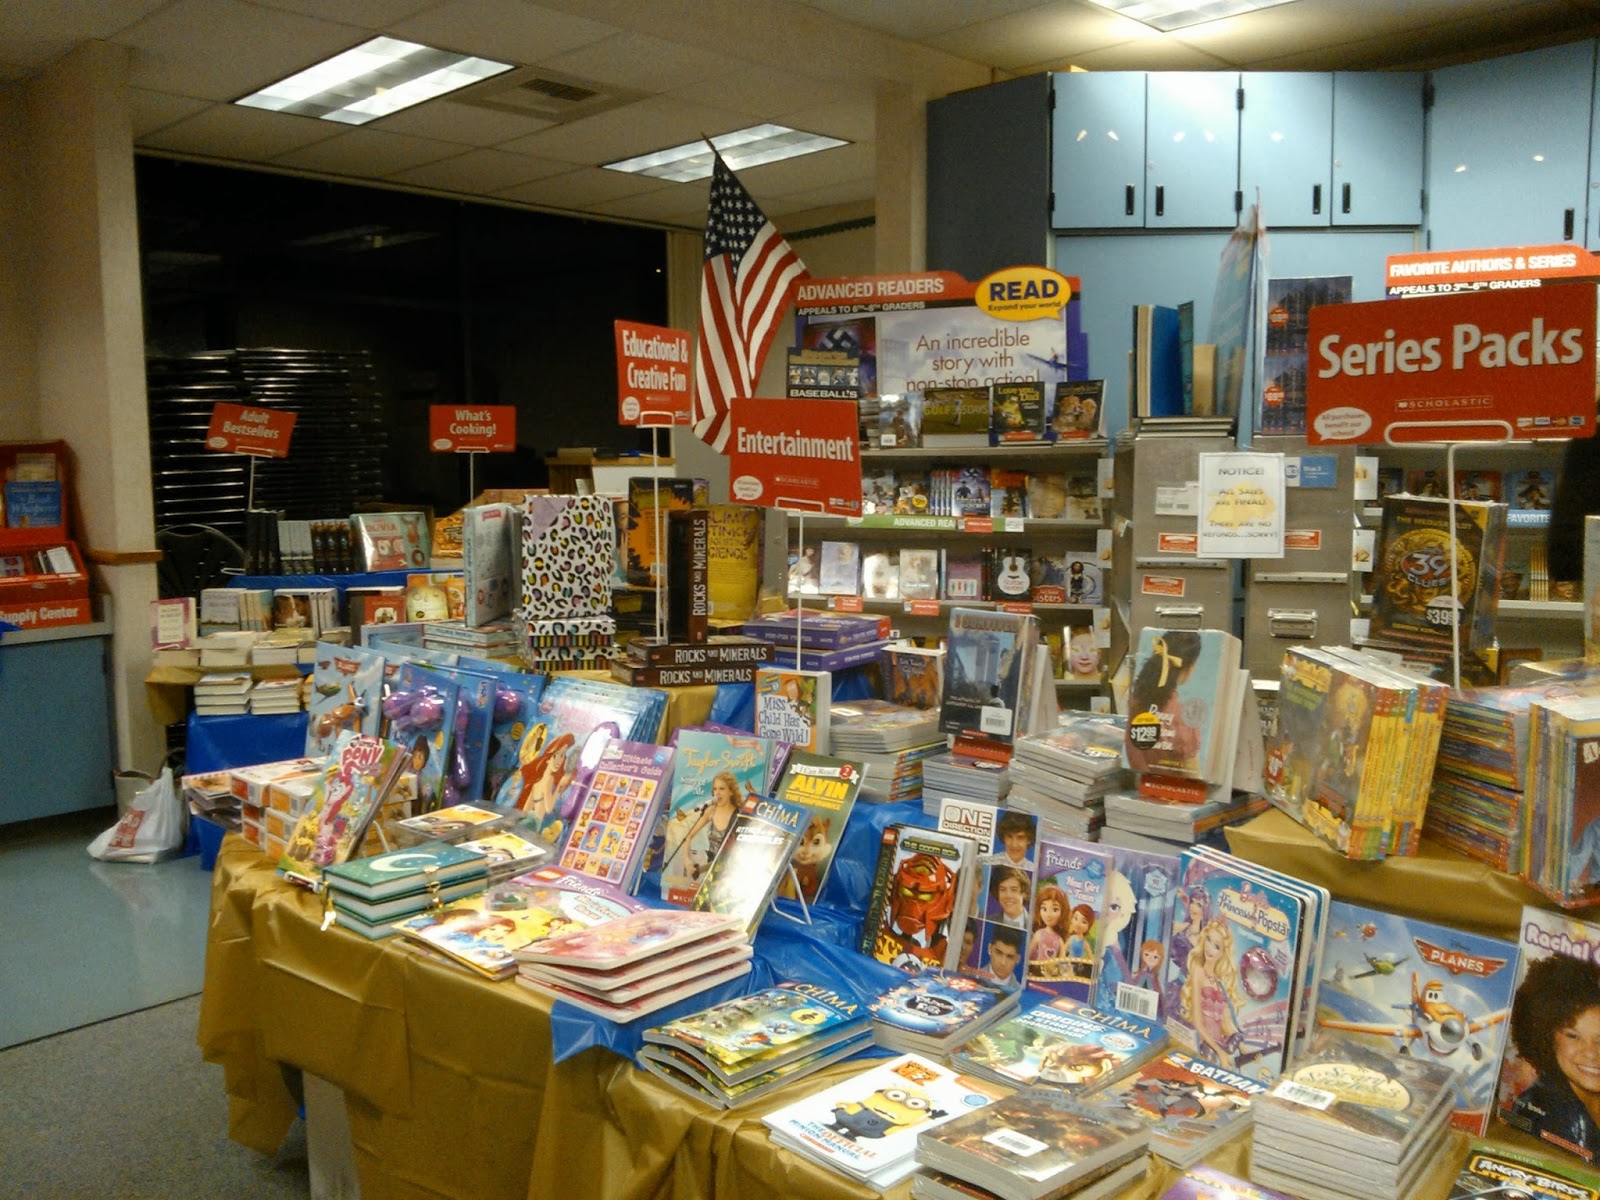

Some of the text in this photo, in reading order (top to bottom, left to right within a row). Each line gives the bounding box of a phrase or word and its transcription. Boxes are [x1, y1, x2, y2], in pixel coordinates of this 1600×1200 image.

[1390, 254, 1576, 277] FAVORITE AUTHORS & SERIES
[797, 278, 945, 301] ADVANCED READERS
[989, 278, 1059, 301] READ
[1389, 283, 1436, 295] APPEALS
[1437, 283, 1451, 293] TO
[1489, 279, 1541, 290] GRADERS
[798, 305, 837, 315] APPEALS
[838, 305, 851, 314] TO
[882, 301, 925, 311] GRADERS
[988, 301, 1061, 312] Expand your world
[622, 329, 688, 363] Educational &
[916, 328, 1030, 352] An incredible
[1318, 317, 1583, 378] Series Packs
[932, 351, 1014, 374] story with
[627, 362, 686, 391] Creative Fun
[790, 388, 858, 399] BASEBALL'S
[1408, 397, 1490, 408] SCHOLASTIC
[240, 409, 270, 424] Adult
[455, 409, 491, 422] What's
[223, 420, 279, 440] Bestsellers
[450, 422, 496, 437] Cooking!
[737, 427, 854, 462] Entertainment
[1219, 467, 1265, 476] NOTICE!
[893, 518, 955, 527] ADVANCED REA
[692, 519, 707, 570] MINERALS
[692, 583, 706, 616] ROCKS
[39, 606, 78, 619] Center
[675, 649, 706, 664] ROCKS
[719, 647, 767, 662] MINERALS
[659, 669, 691, 685] ROCKS
[704, 668, 752, 683] MINERALS
[764, 697, 786, 711] Miss
[759, 710, 801, 727] Child Has
[760, 726, 808, 743] Gone Wild!
[621, 753, 653, 766] Ultimate
[682, 747, 757, 774] Taylor Swift
[640, 765, 663, 777] Guide
[843, 767, 851, 776] 2
[789, 774, 849, 800] ALVIN
[756, 801, 799, 828] CHIMA
[944, 805, 993, 828] ONE
[942, 822, 992, 836] DIRECTION
[1046, 849, 1082, 870] Friends
[1430, 949, 1485, 973] PLANES
[795, 984, 858, 1015] CHIMA
[1078, 1007, 1151, 1039] CHIMA
[1189, 1062, 1266, 1094] BATMAN
[789, 1119, 821, 1139] MINION
[822, 1138, 861, 1160] MANUAL
[822, 1131, 877, 1158] OFFICIAL
[1478, 1160, 1532, 1184] ANGRY
